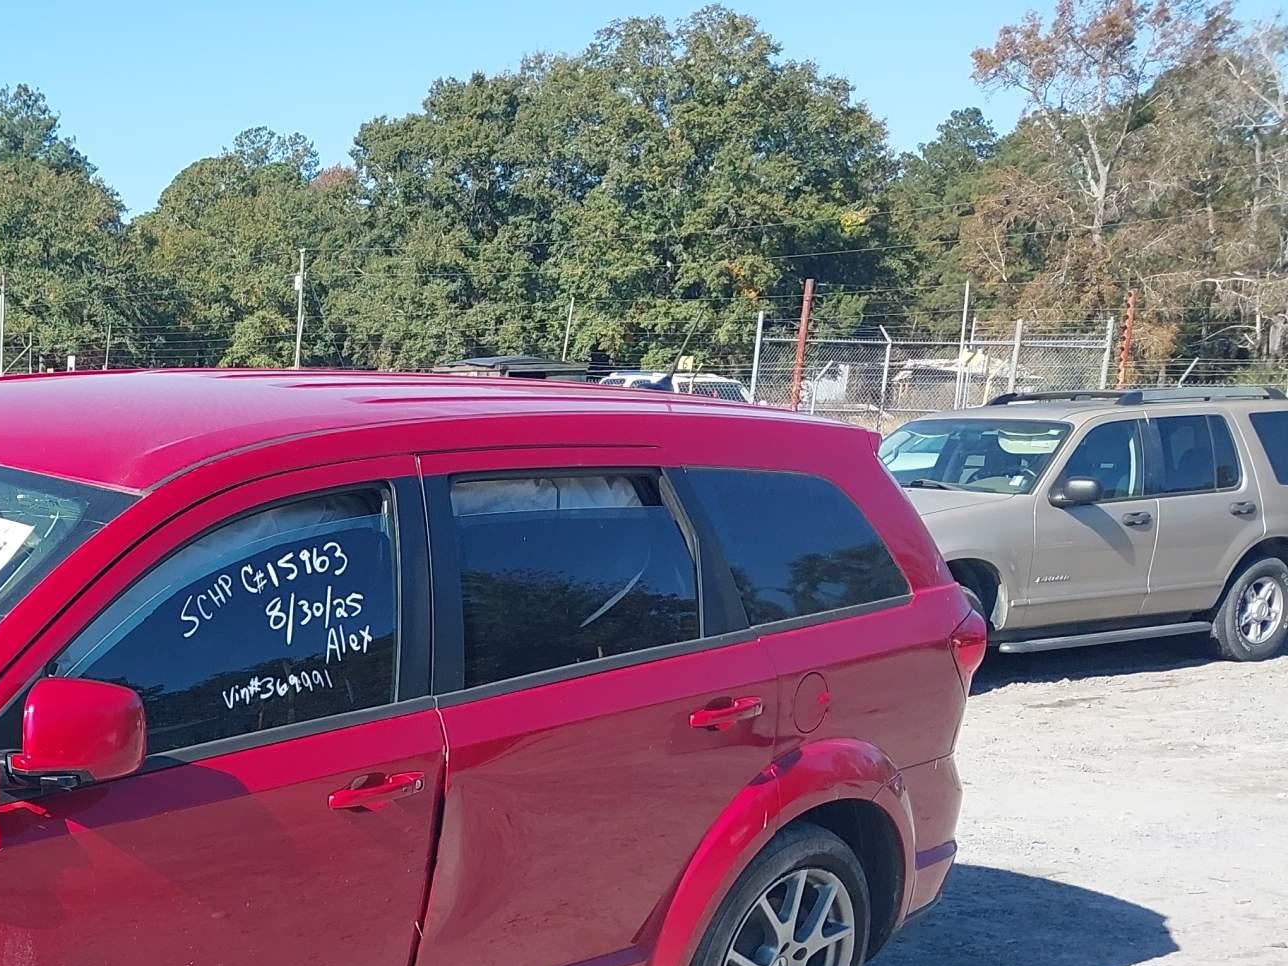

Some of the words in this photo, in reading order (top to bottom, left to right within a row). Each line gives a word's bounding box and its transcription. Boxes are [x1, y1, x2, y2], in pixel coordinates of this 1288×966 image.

[181, 574, 233, 637] SCHP
[266, 585, 364, 645] 8/30/25
[326, 624, 373, 664] Alex
